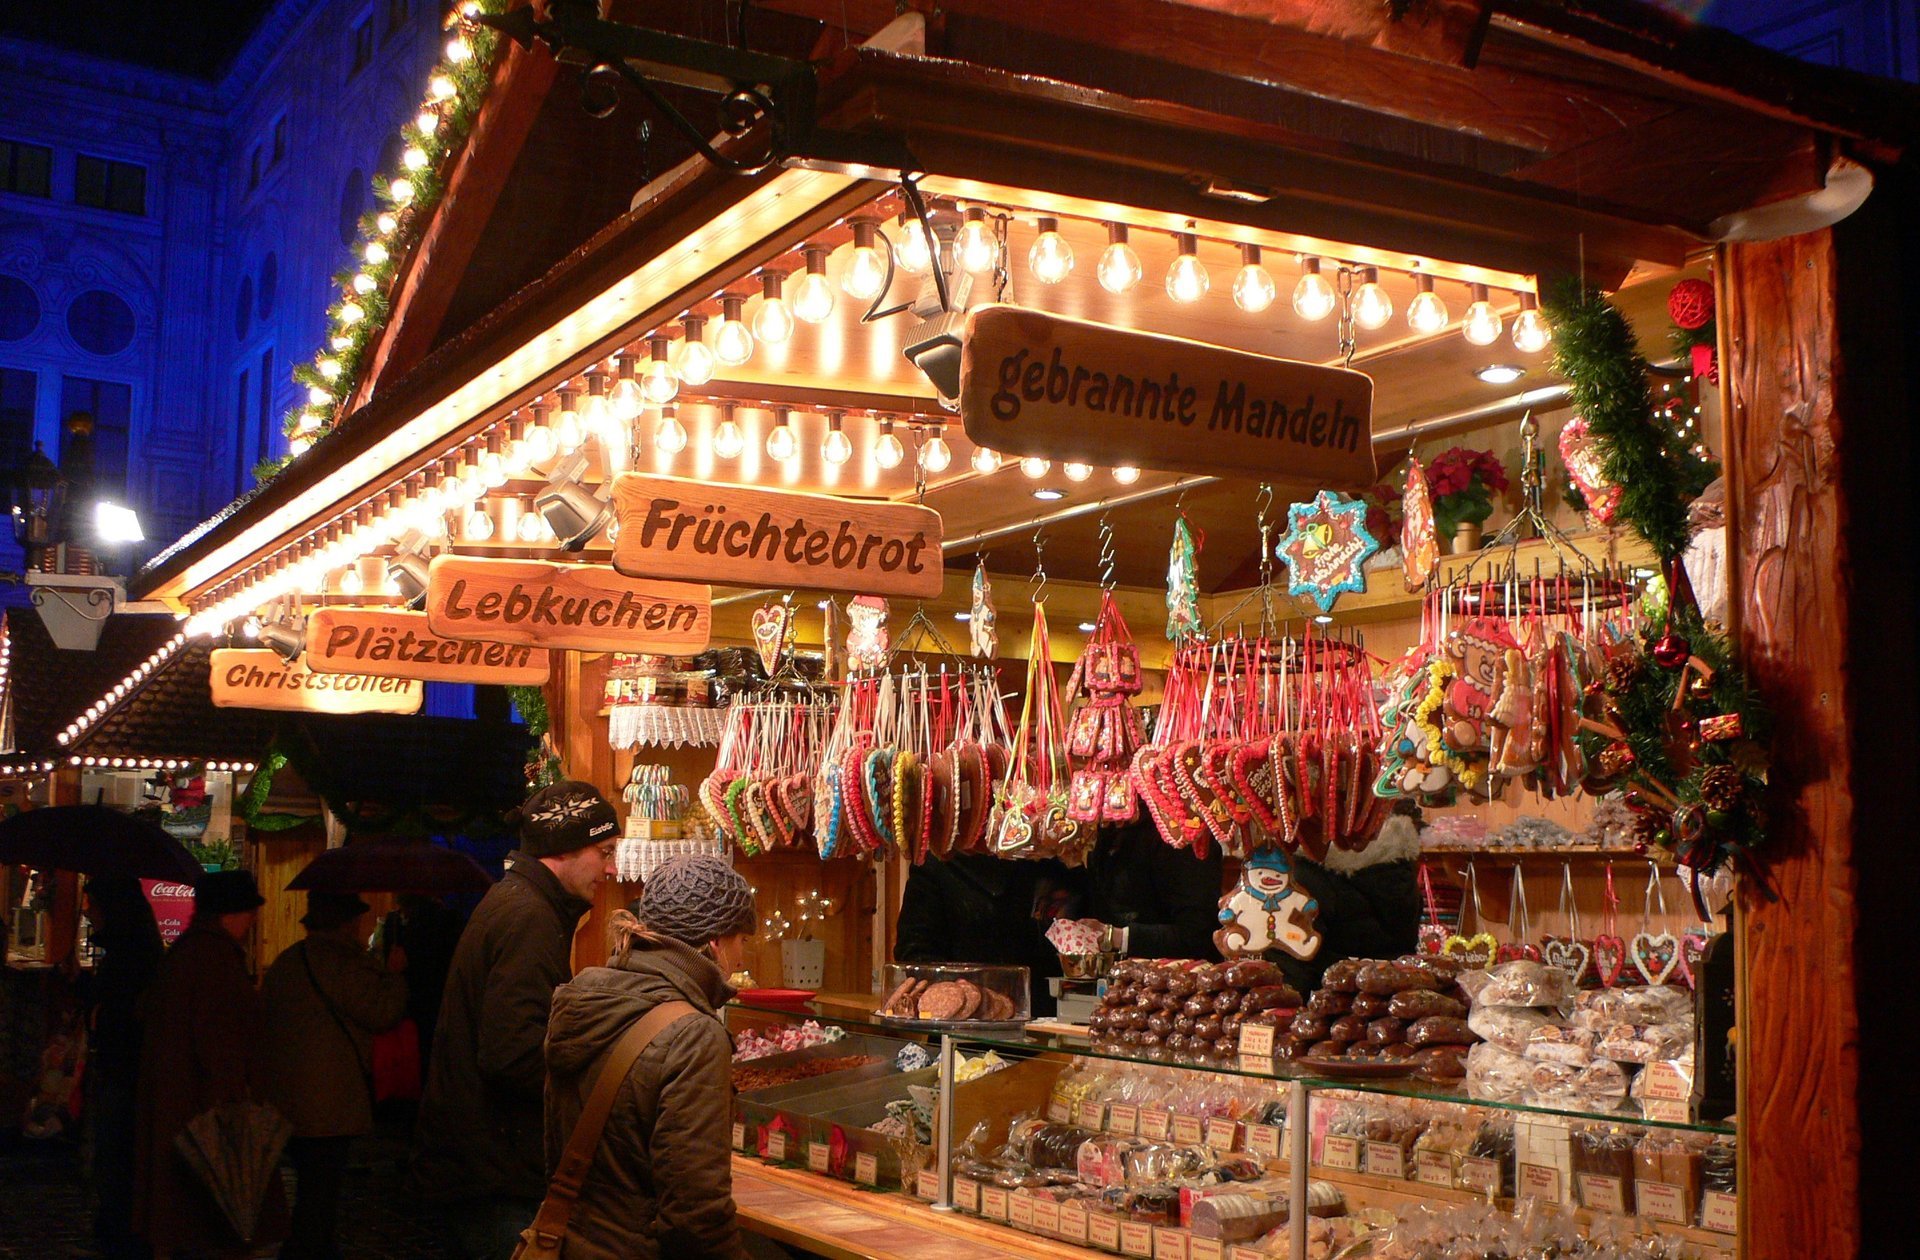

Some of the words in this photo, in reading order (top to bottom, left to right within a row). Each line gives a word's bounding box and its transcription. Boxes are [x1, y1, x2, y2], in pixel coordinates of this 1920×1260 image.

[990, 347, 1197, 426] gebrannte
[1207, 379, 1361, 454] Mandeln
[640, 499, 927, 575] Früchtebrot
[444, 579, 699, 632] Lebkuchen
[325, 625, 534, 668] Plätzchen
